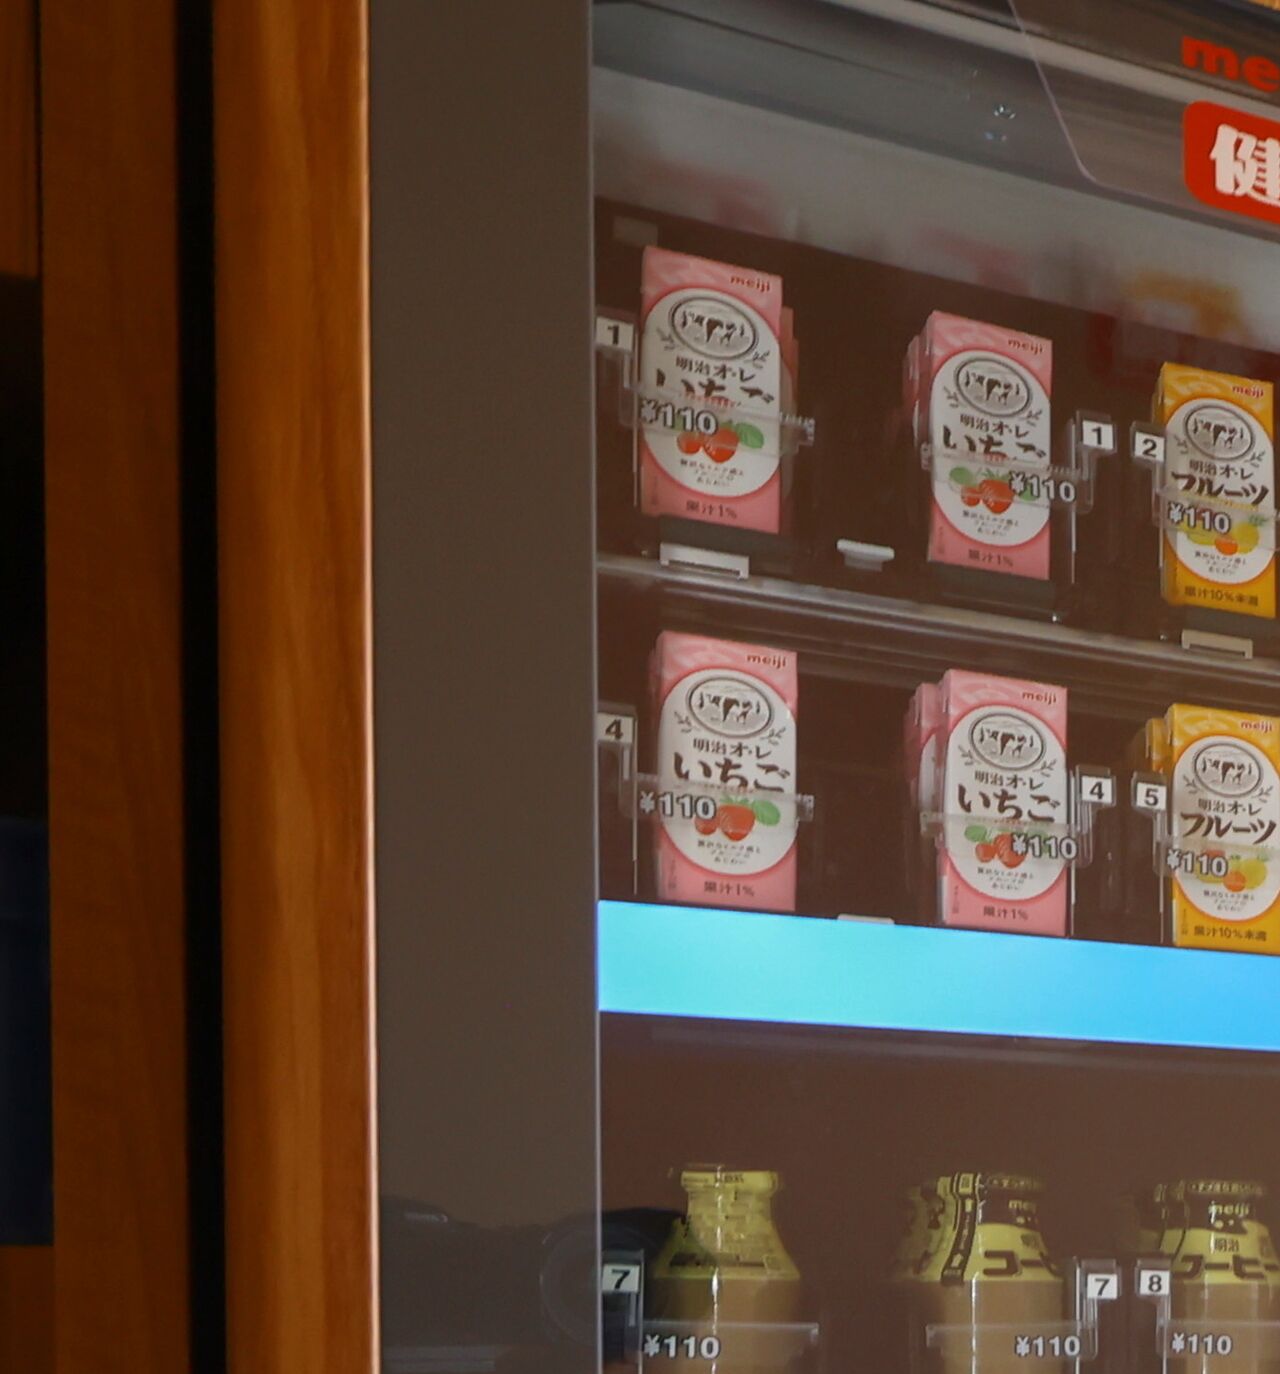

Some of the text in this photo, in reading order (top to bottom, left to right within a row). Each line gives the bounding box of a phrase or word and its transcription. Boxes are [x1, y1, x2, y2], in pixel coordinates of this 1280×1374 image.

[606, 324, 620, 346] 1
[1232, 383, 1264, 399] meiji
[641, 400, 719, 435] ¥110
[1091, 426, 1103, 446] 1
[1142, 437, 1157, 458] 2
[1009, 469, 1075, 502] ¥110
[1171, 473, 1270, 506] フルーツ
[1168, 501, 1231, 535] ¥110
[747, 653, 787, 669] meiji
[1022, 691, 1057, 705] meiji
[605, 719, 623, 741] 4
[1240, 720, 1272, 733] meiji
[674, 752, 790, 793] いちご
[1089, 781, 1104, 800] 4
[1144, 788, 1159, 807] 5
[641, 790, 717, 819] ¥110
[957, 783, 1060, 823] いちご
[1180, 813, 1277, 845] フルーツ
[1010, 832, 1078, 859] ¥110
[1166, 847, 1228, 877] ¥110
[1208, 1202, 1250, 1217] meiji
[611, 1269, 631, 1290] 7
[1095, 1277, 1109, 1297] 7
[1148, 1274, 1161, 1293] 8
[644, 1335, 721, 1360] ¥110
[1016, 1335, 1081, 1357] ¥110
[1172, 1333, 1232, 1354] ¥110
